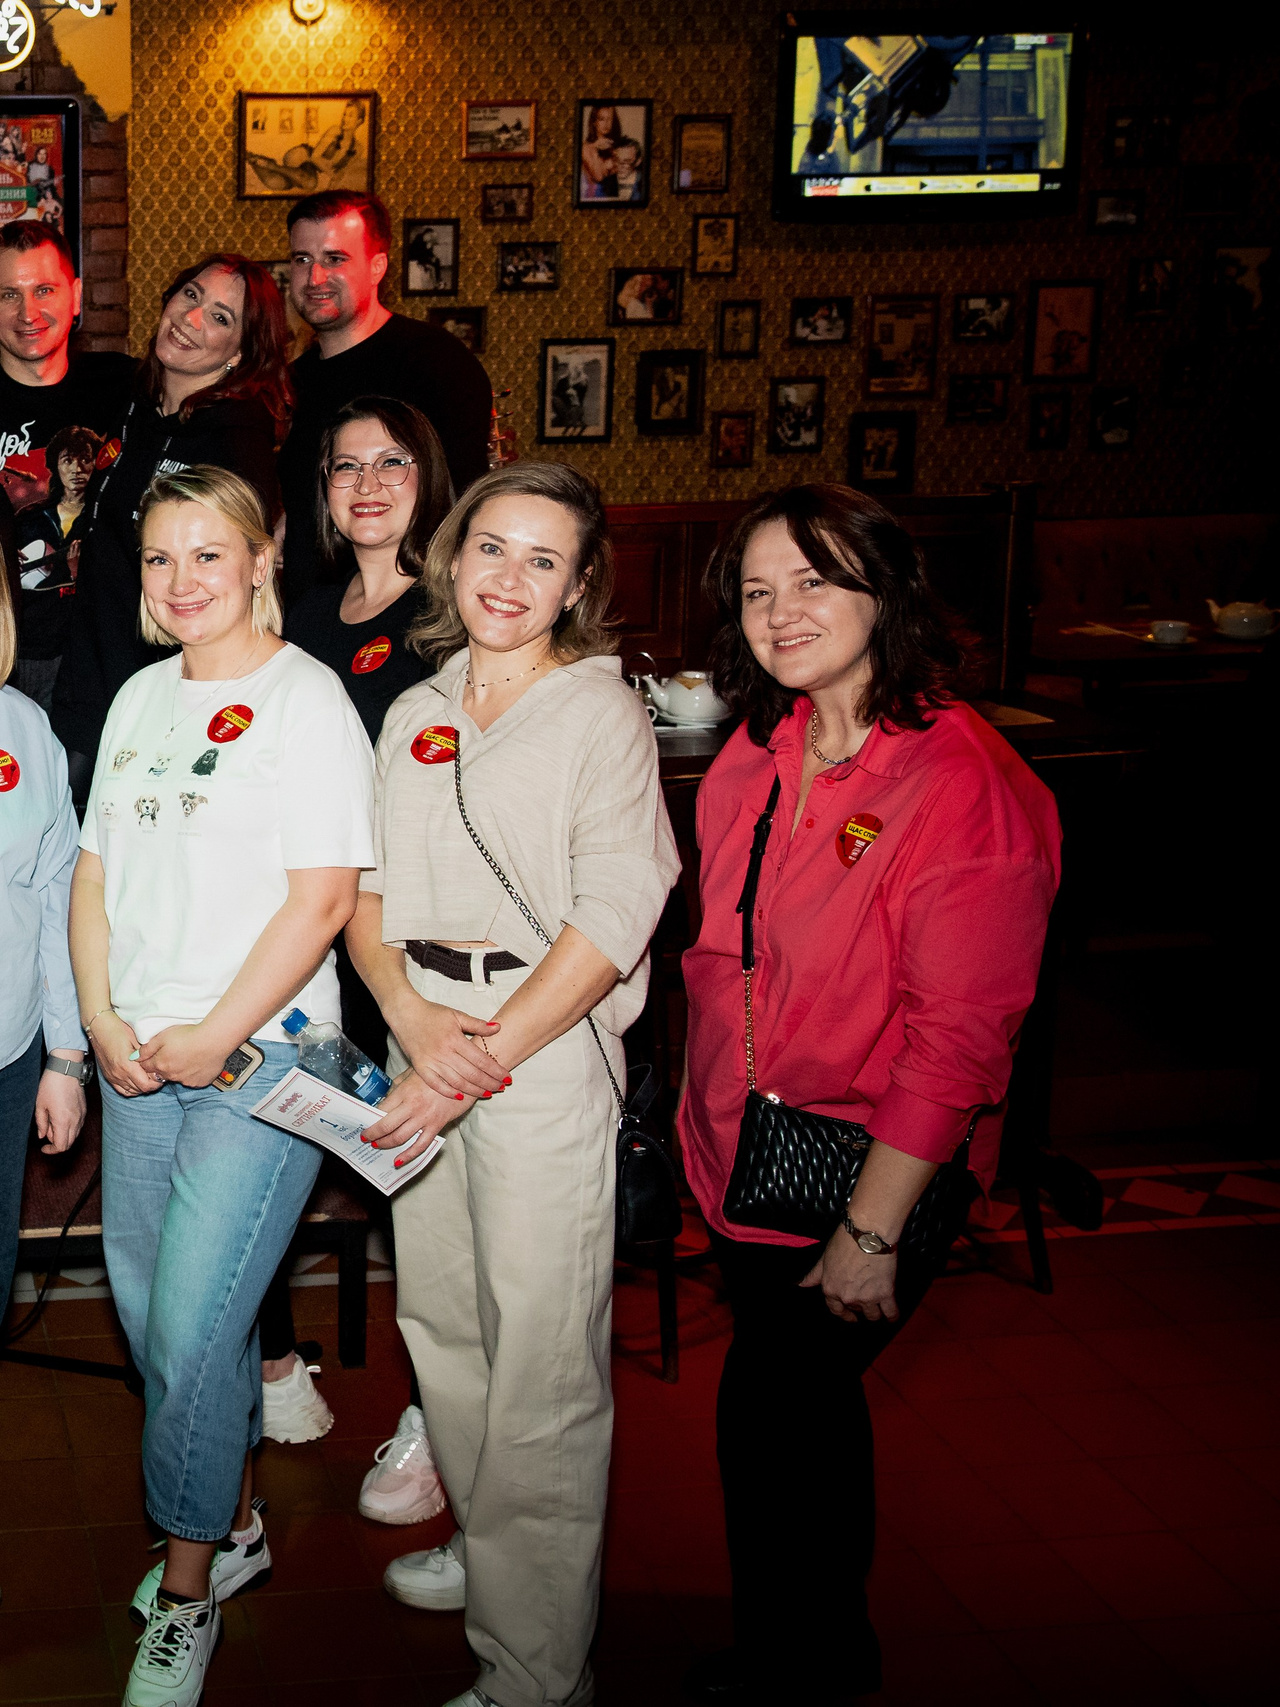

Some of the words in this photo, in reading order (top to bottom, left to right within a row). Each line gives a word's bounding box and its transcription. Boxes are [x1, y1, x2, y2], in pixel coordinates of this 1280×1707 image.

[425, 733, 440, 741] ЩАС
[848, 825, 864, 835] ЩАС
[291, 1094, 331, 1128] СЕРТИФИКАТ
[320, 1117, 339, 1129] 1
